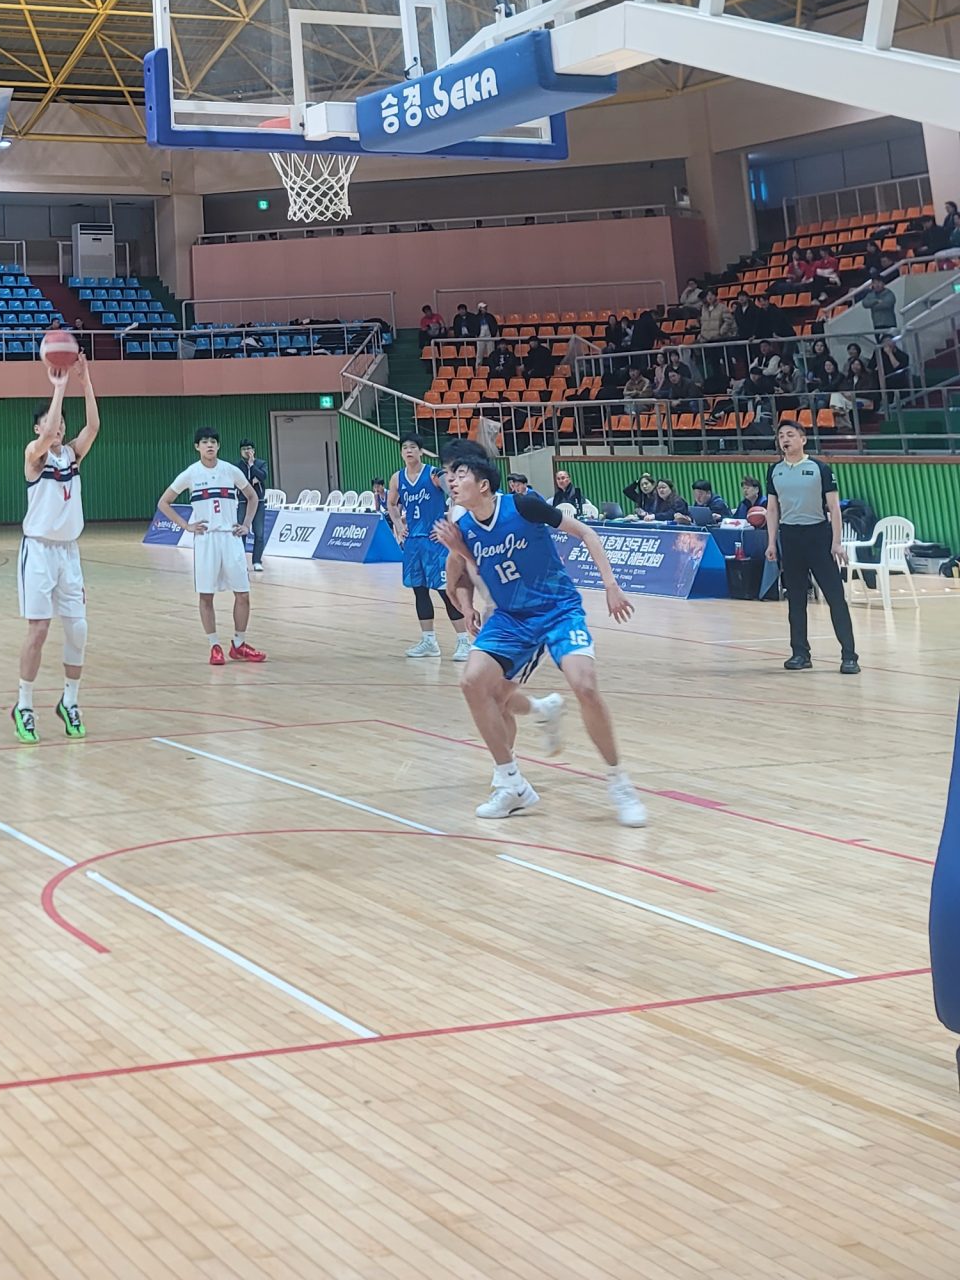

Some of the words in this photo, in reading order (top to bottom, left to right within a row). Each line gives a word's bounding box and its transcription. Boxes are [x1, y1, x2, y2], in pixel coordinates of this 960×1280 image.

[381, 83, 422, 134] 승경
[427, 67, 498, 119] SEKA
[213, 499, 221, 513] 2
[332, 524, 367, 539] molten
[473, 533, 528, 566] JeonJu
[494, 560, 521, 584] 12
[568, 629, 589, 646] 12
